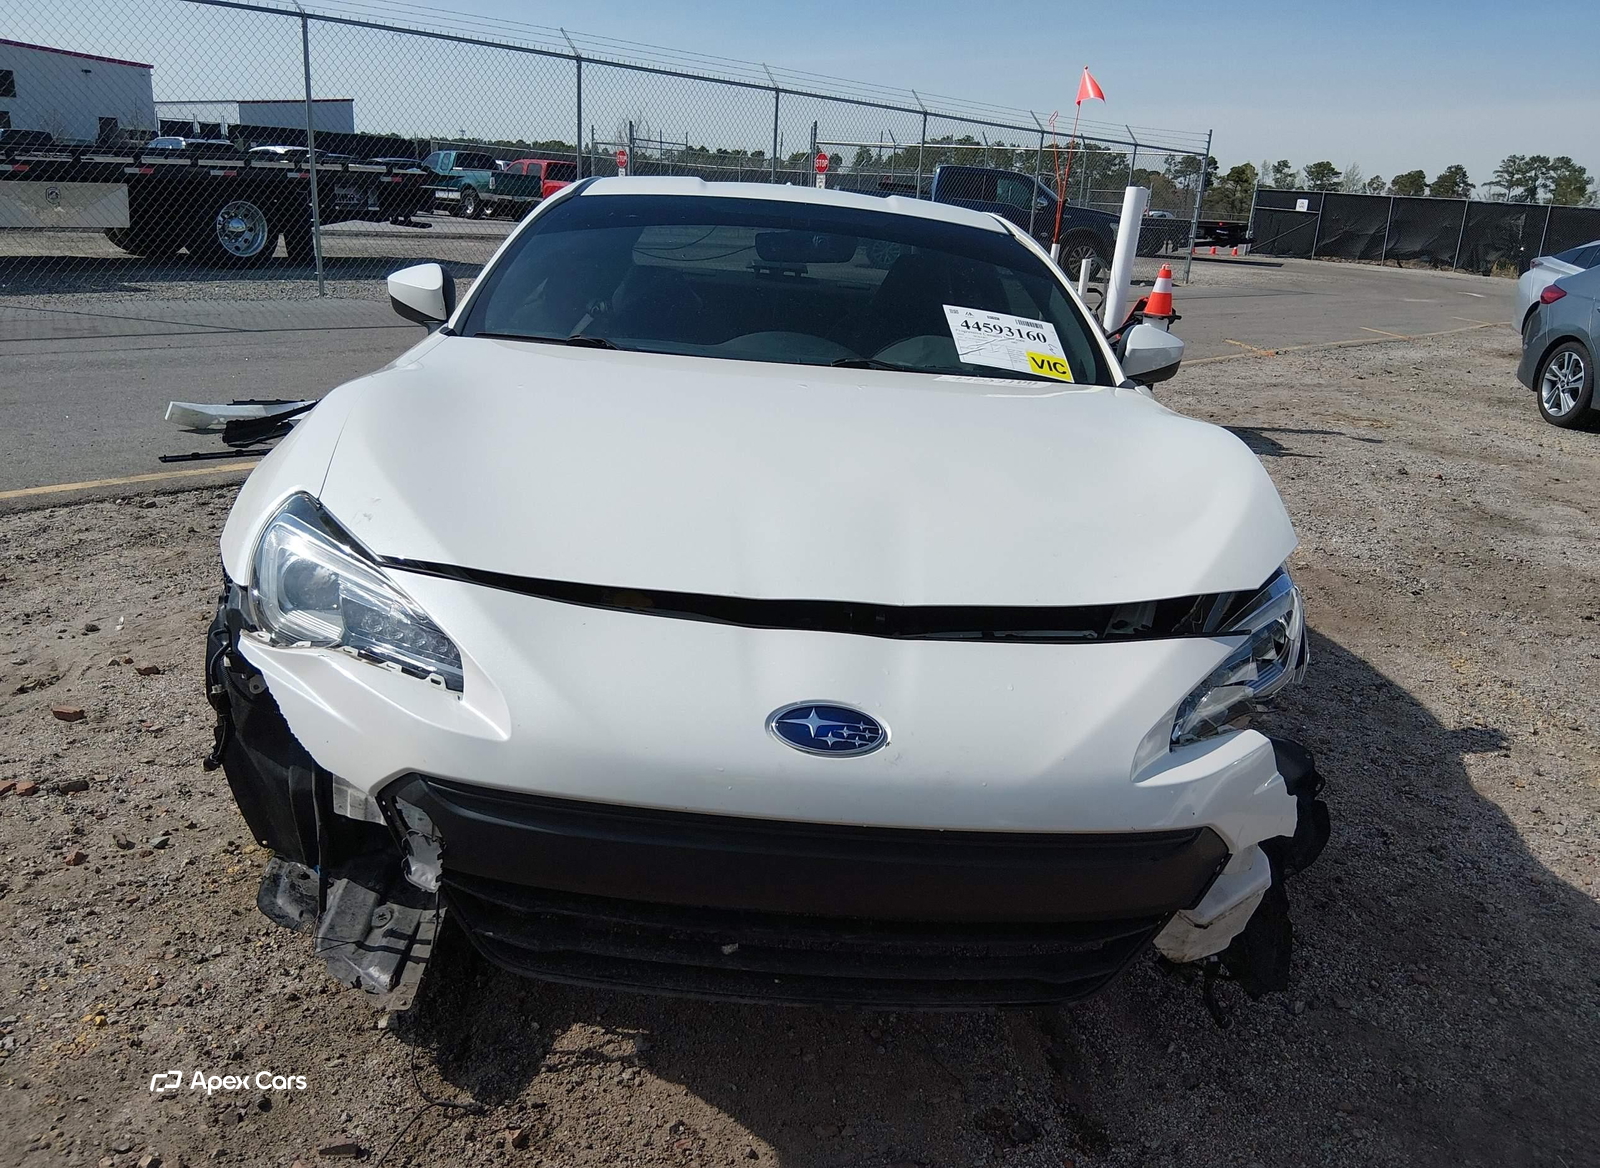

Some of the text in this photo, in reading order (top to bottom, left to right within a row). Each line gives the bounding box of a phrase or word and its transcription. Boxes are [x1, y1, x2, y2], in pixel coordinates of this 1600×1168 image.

[816, 159, 828, 168] STOP
[960, 319, 1047, 343] 44593160
[1031, 356, 1067, 375] VIC
